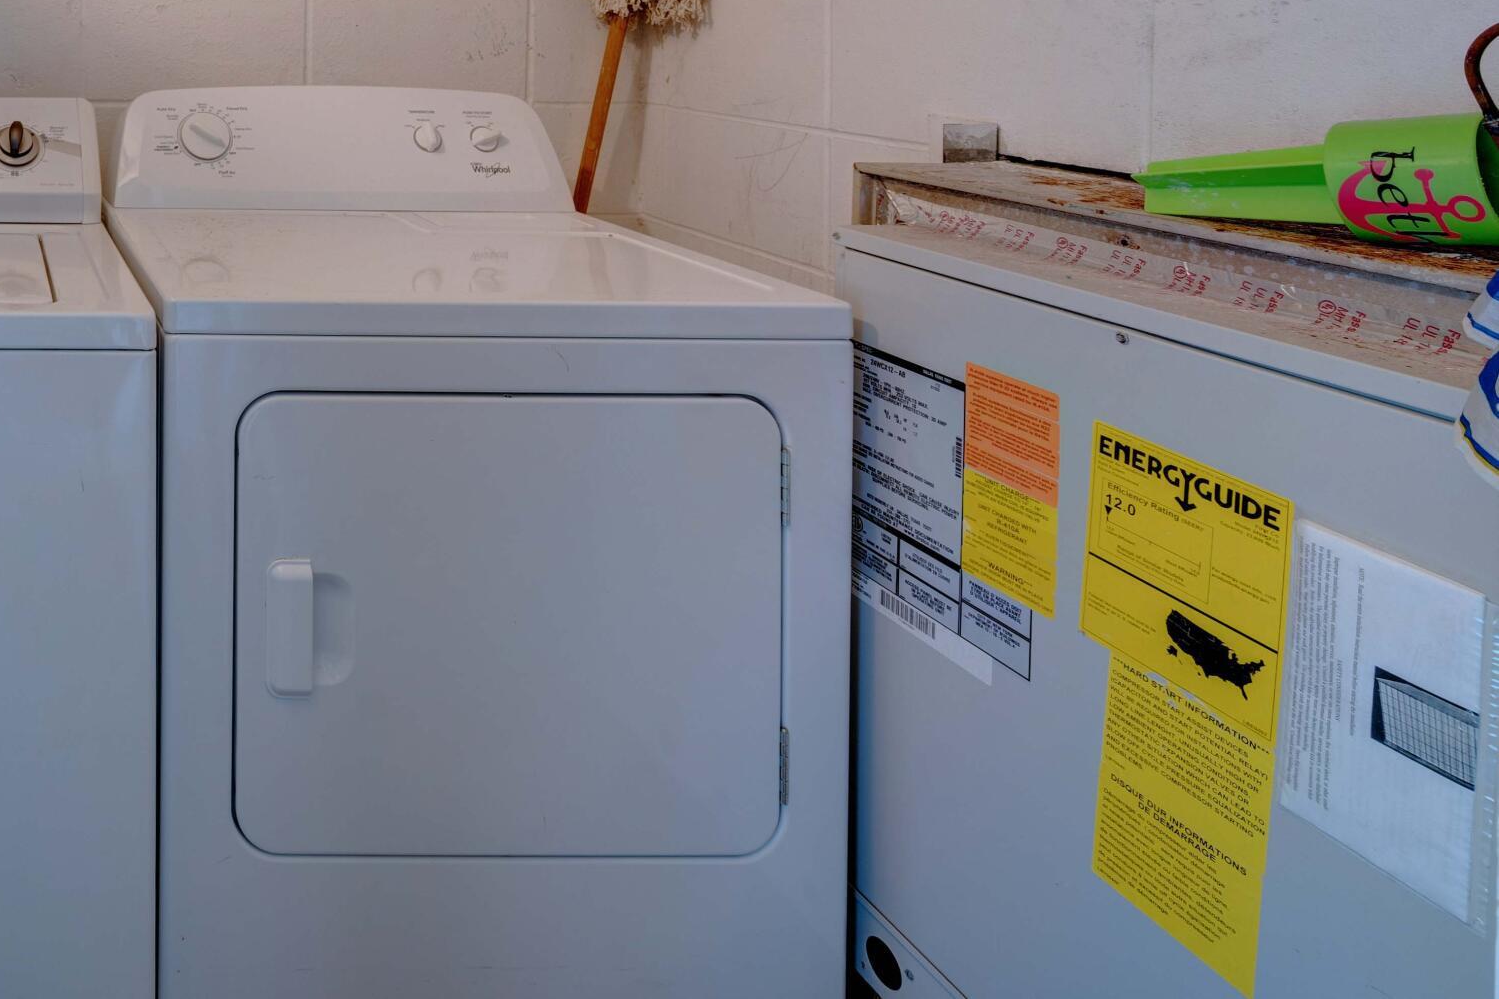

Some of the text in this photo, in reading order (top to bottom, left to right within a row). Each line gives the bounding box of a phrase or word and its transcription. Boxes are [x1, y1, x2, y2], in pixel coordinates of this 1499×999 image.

[473, 165, 511, 175] Whirlpool
[1099, 434, 1281, 532] ENERGYGUIDE
[1105, 491, 1136, 517] 12.0
[1107, 481, 1179, 522] Efficiency Rating
[1112, 668, 1160, 702] COMPRESSOR
[1186, 714, 1212, 736] ASSIST
[1214, 732, 1248, 759] DEVICES
[1157, 732, 1200, 765] OPERATING
[1178, 737, 1223, 771] UNUSUALLY
[1225, 767, 1245, 785] HIGH
[1247, 781, 1259, 794] OR
[1186, 733, 1241, 773] INSTALLATIONS
[1243, 769, 1262, 787] WITH
[1194, 728, 1237, 761] POTENTIAL
[1146, 742, 1184, 773] SITUATION
[1184, 768, 1210, 790] WHICH
[1211, 786, 1227, 802] CAN
[1230, 799, 1252, 819] LEAD
[1253, 814, 1265, 827] TO
[1161, 743, 1204, 776] EXPANSION
[1205, 772, 1235, 797] VALVES
[1237, 793, 1249, 807] OR
[1165, 764, 1205, 796] PRESSURE
[1207, 792, 1265, 837] EQUALIZATION
[1110, 772, 1247, 877] DISQUE DUR INFORMATIONS
[1137, 800, 1150, 816] DE
[1214, 806, 1254, 839] STARTING
